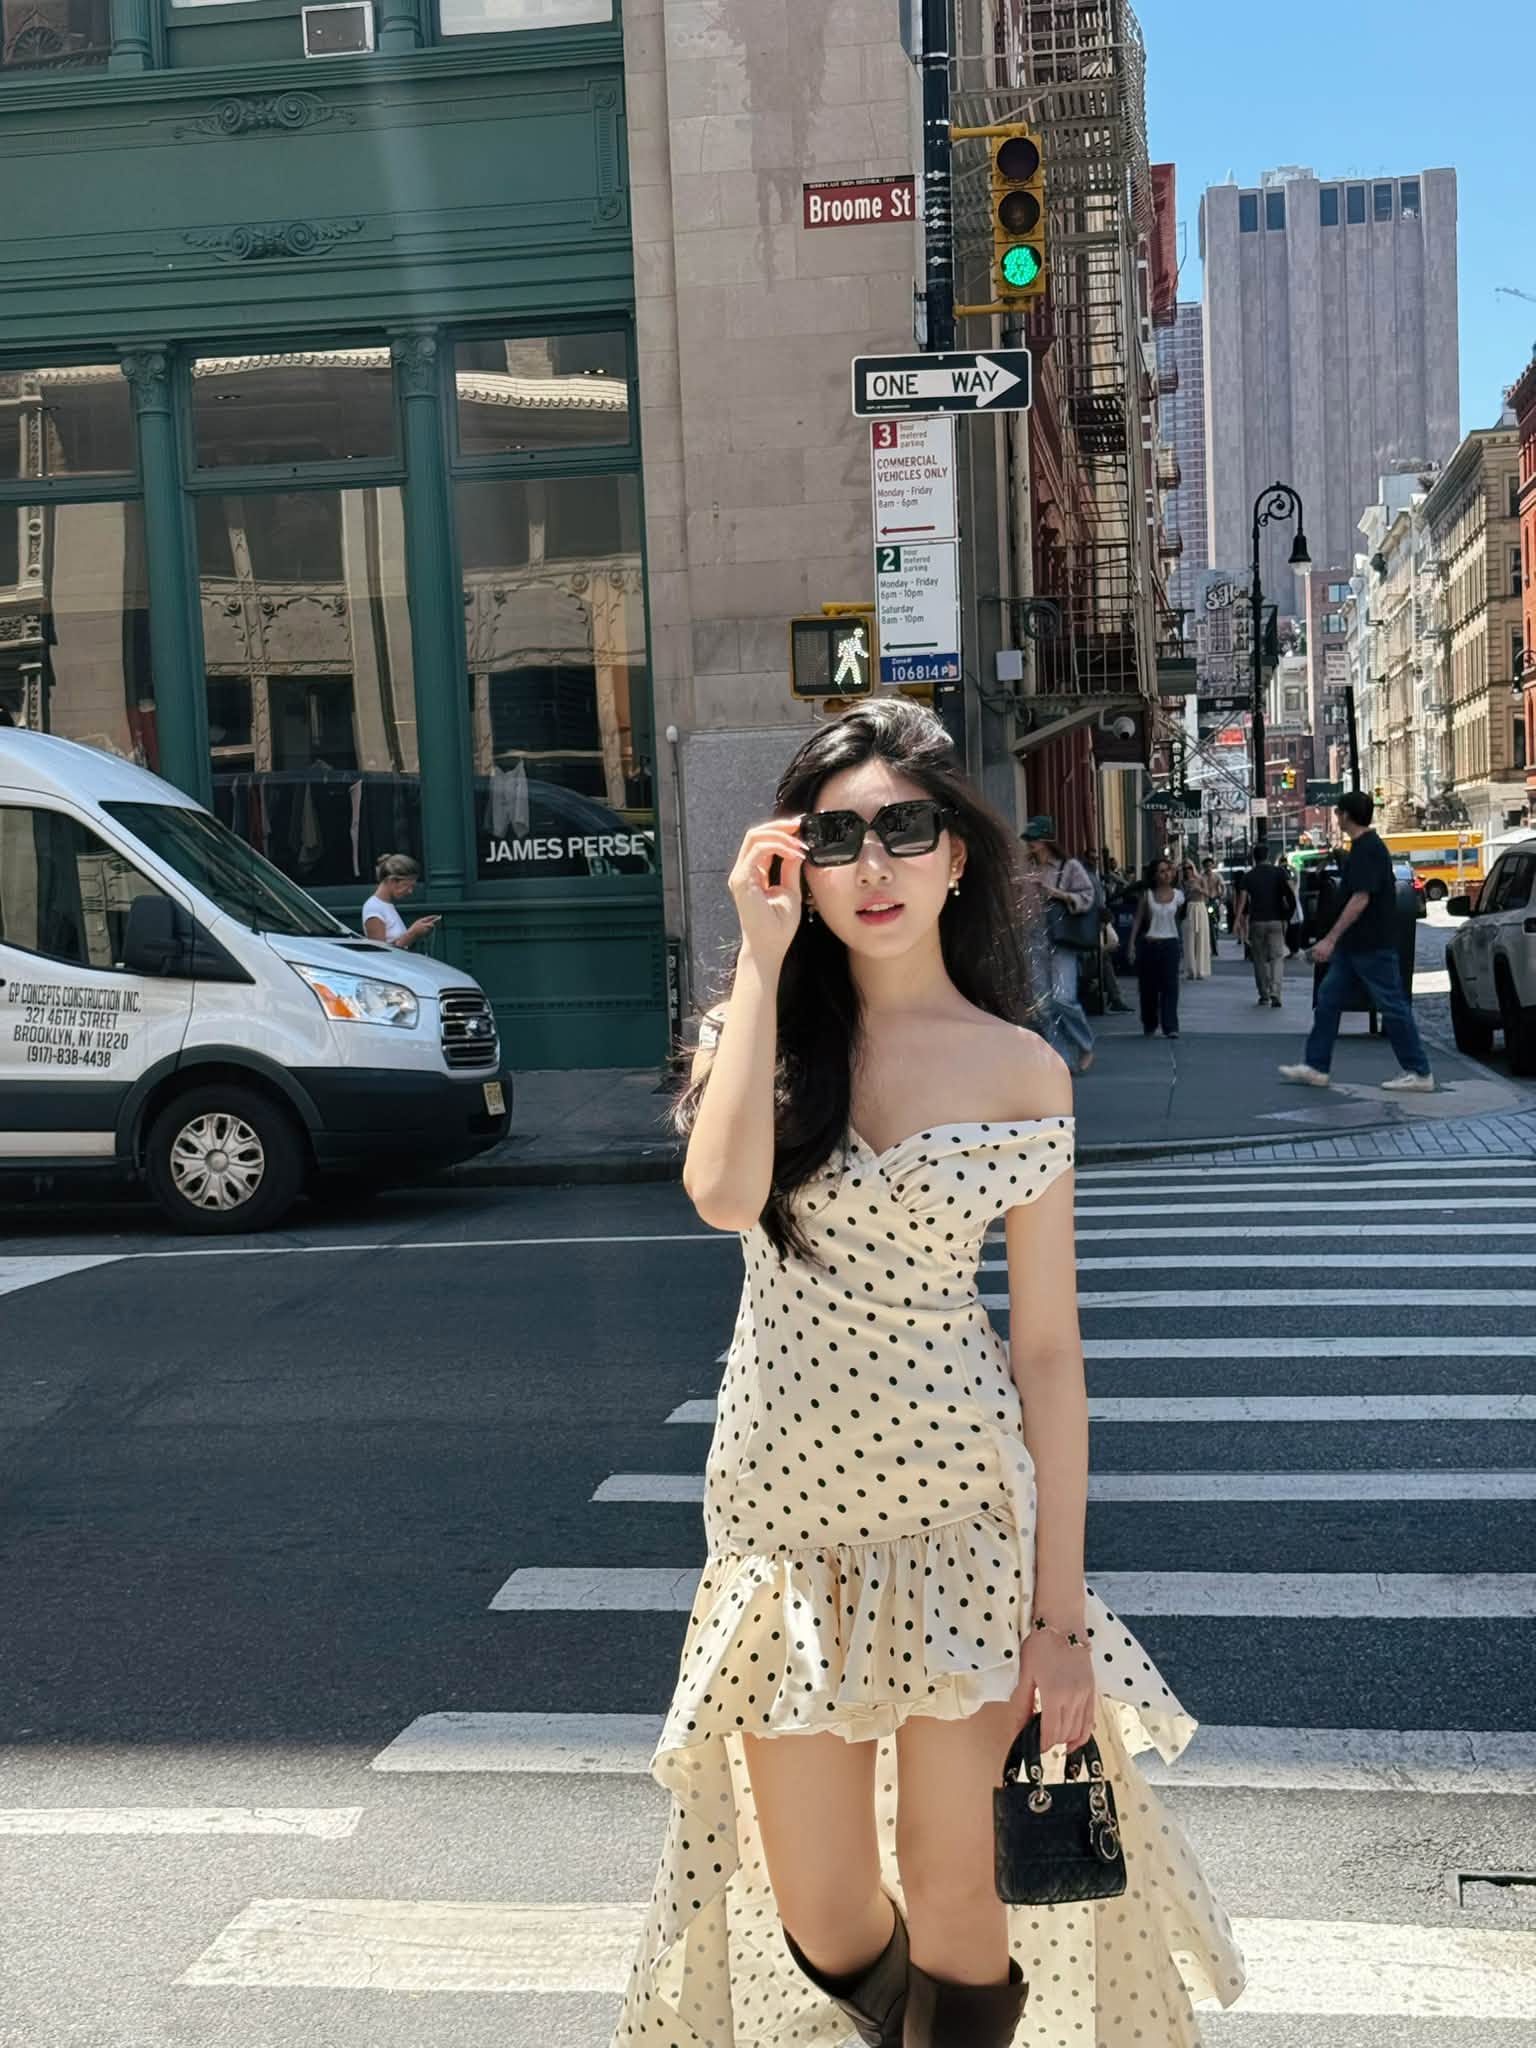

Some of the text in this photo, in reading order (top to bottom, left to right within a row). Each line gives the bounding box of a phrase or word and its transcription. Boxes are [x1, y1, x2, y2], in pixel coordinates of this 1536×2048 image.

[809, 187, 912, 224] Broome St
[873, 369, 999, 397] ONE WAY
[878, 423, 892, 447] 3
[877, 454, 938, 470] COMMERCIAL
[877, 466, 948, 483] VEHICLES ONLY
[878, 488, 904, 497] Monday
[911, 486, 933, 496] Friday
[878, 500, 895, 508] 8am
[902, 498, 918, 508] 6pm
[882, 548, 896, 571] 2
[880, 579, 908, 588] Monday
[916, 577, 939, 587] Friday
[880, 591, 897, 600] 6pm
[904, 589, 924, 599] 10pm
[881, 604, 914, 614] Saturday
[904, 614, 924, 624] 10pm
[891, 664, 939, 681] 106814
[485, 833, 646, 863] JAMES PERSE
[21, 983, 61, 1006] CONCEPTS
[62, 986, 121, 1010] CONSTRUCTION
[122, 990, 141, 1013] INC.
[25, 1006, 119, 1030] 321 46TH STREET
[14, 1024, 129, 1050] BROOKLYN, NY 11220
[27, 1045, 112, 1068] (917)-838-4438
